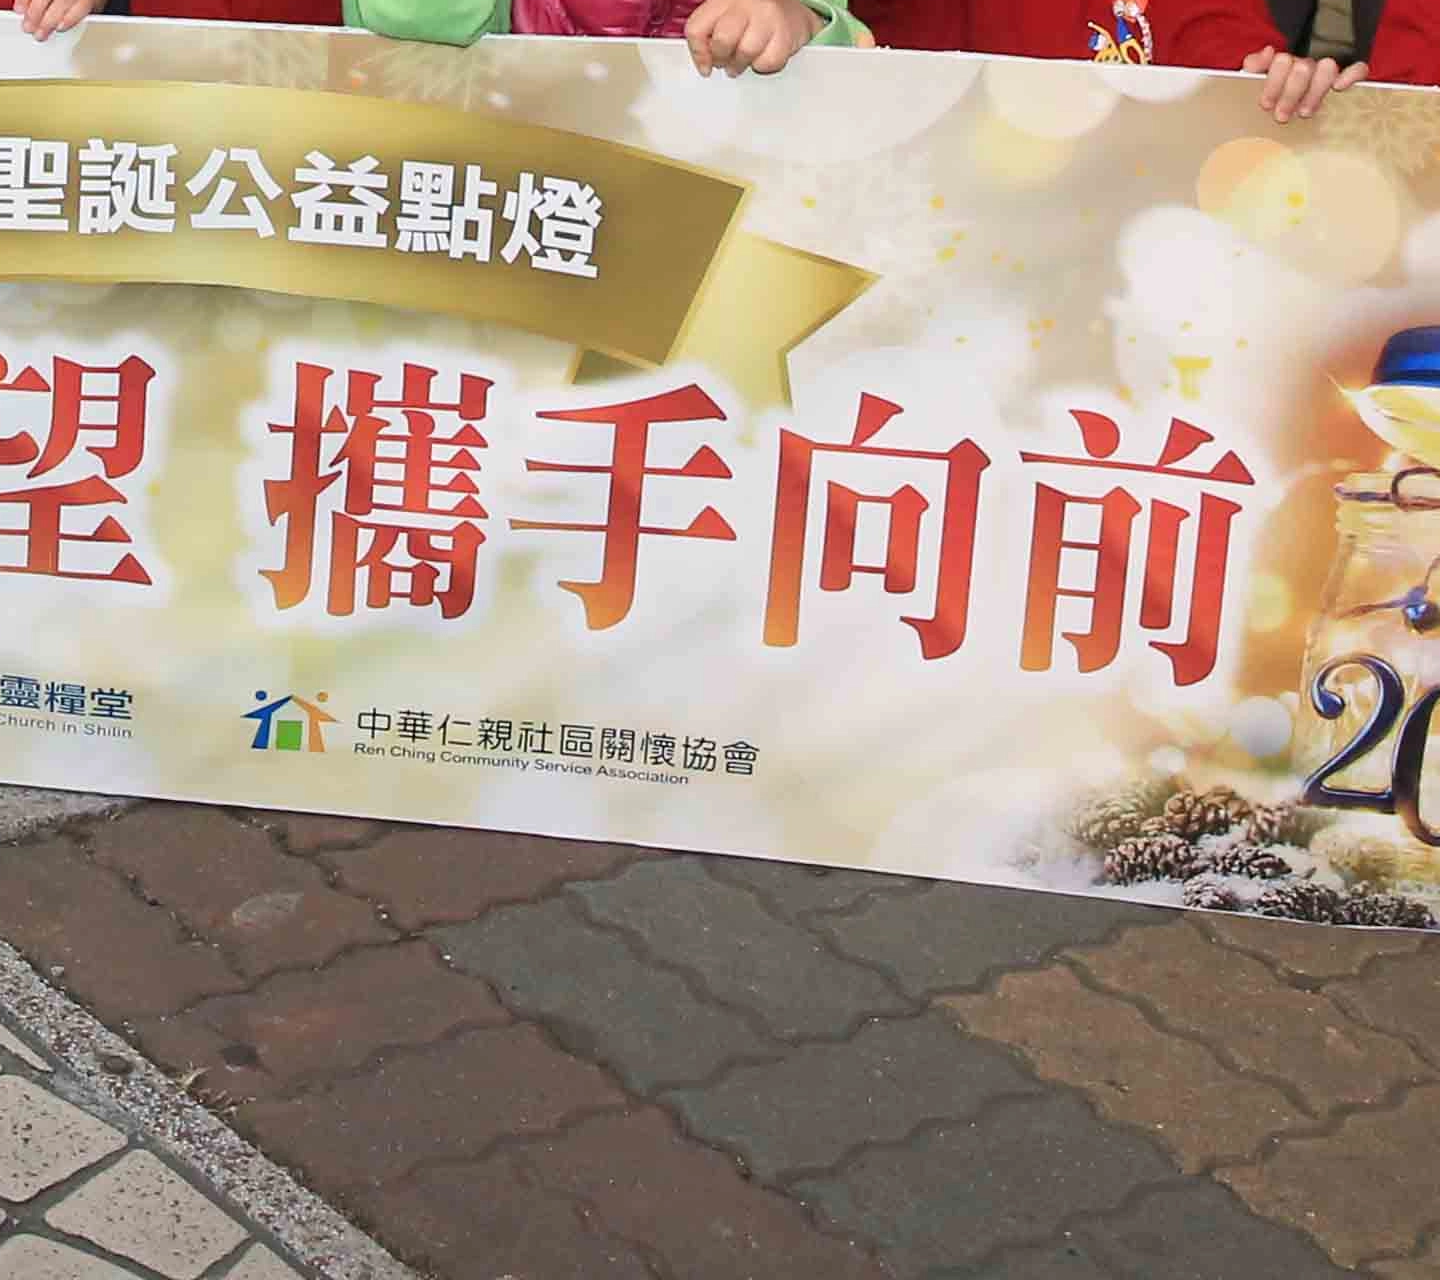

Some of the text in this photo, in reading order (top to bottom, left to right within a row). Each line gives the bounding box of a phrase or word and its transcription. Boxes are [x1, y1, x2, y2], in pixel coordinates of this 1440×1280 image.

[257, 361, 1258, 688] 攜手向前
[61, 721, 78, 734] in
[83, 722, 134, 739] Shilin
[355, 706, 761, 778] 中華仁親社區關懷協會
[353, 742, 690, 786] Ren Ching Community Service Association
